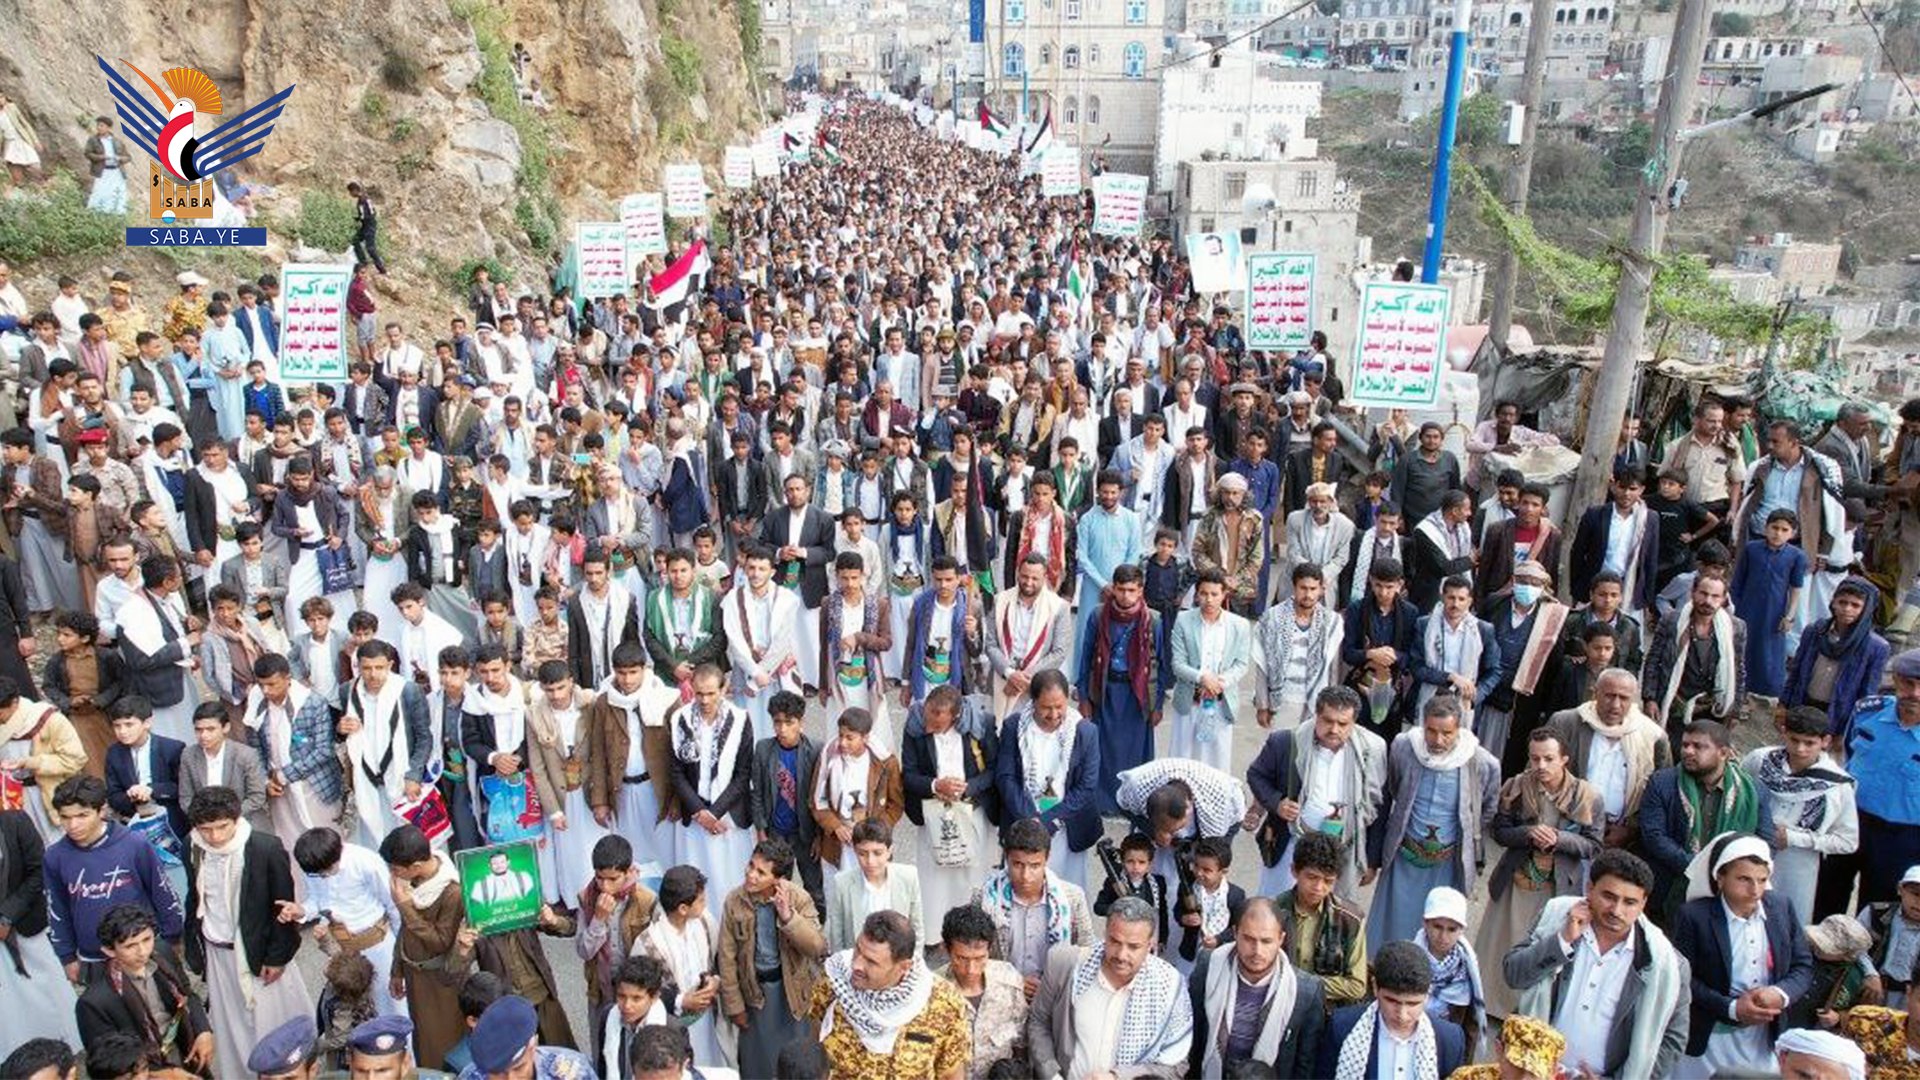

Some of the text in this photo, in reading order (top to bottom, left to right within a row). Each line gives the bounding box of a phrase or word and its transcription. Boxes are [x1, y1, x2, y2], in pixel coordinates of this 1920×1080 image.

[1288, 260, 1311, 275] الله
[323, 281, 343, 295] الله
[1415, 297, 1443, 313] الله
[1398, 376, 1432, 397] النصر
